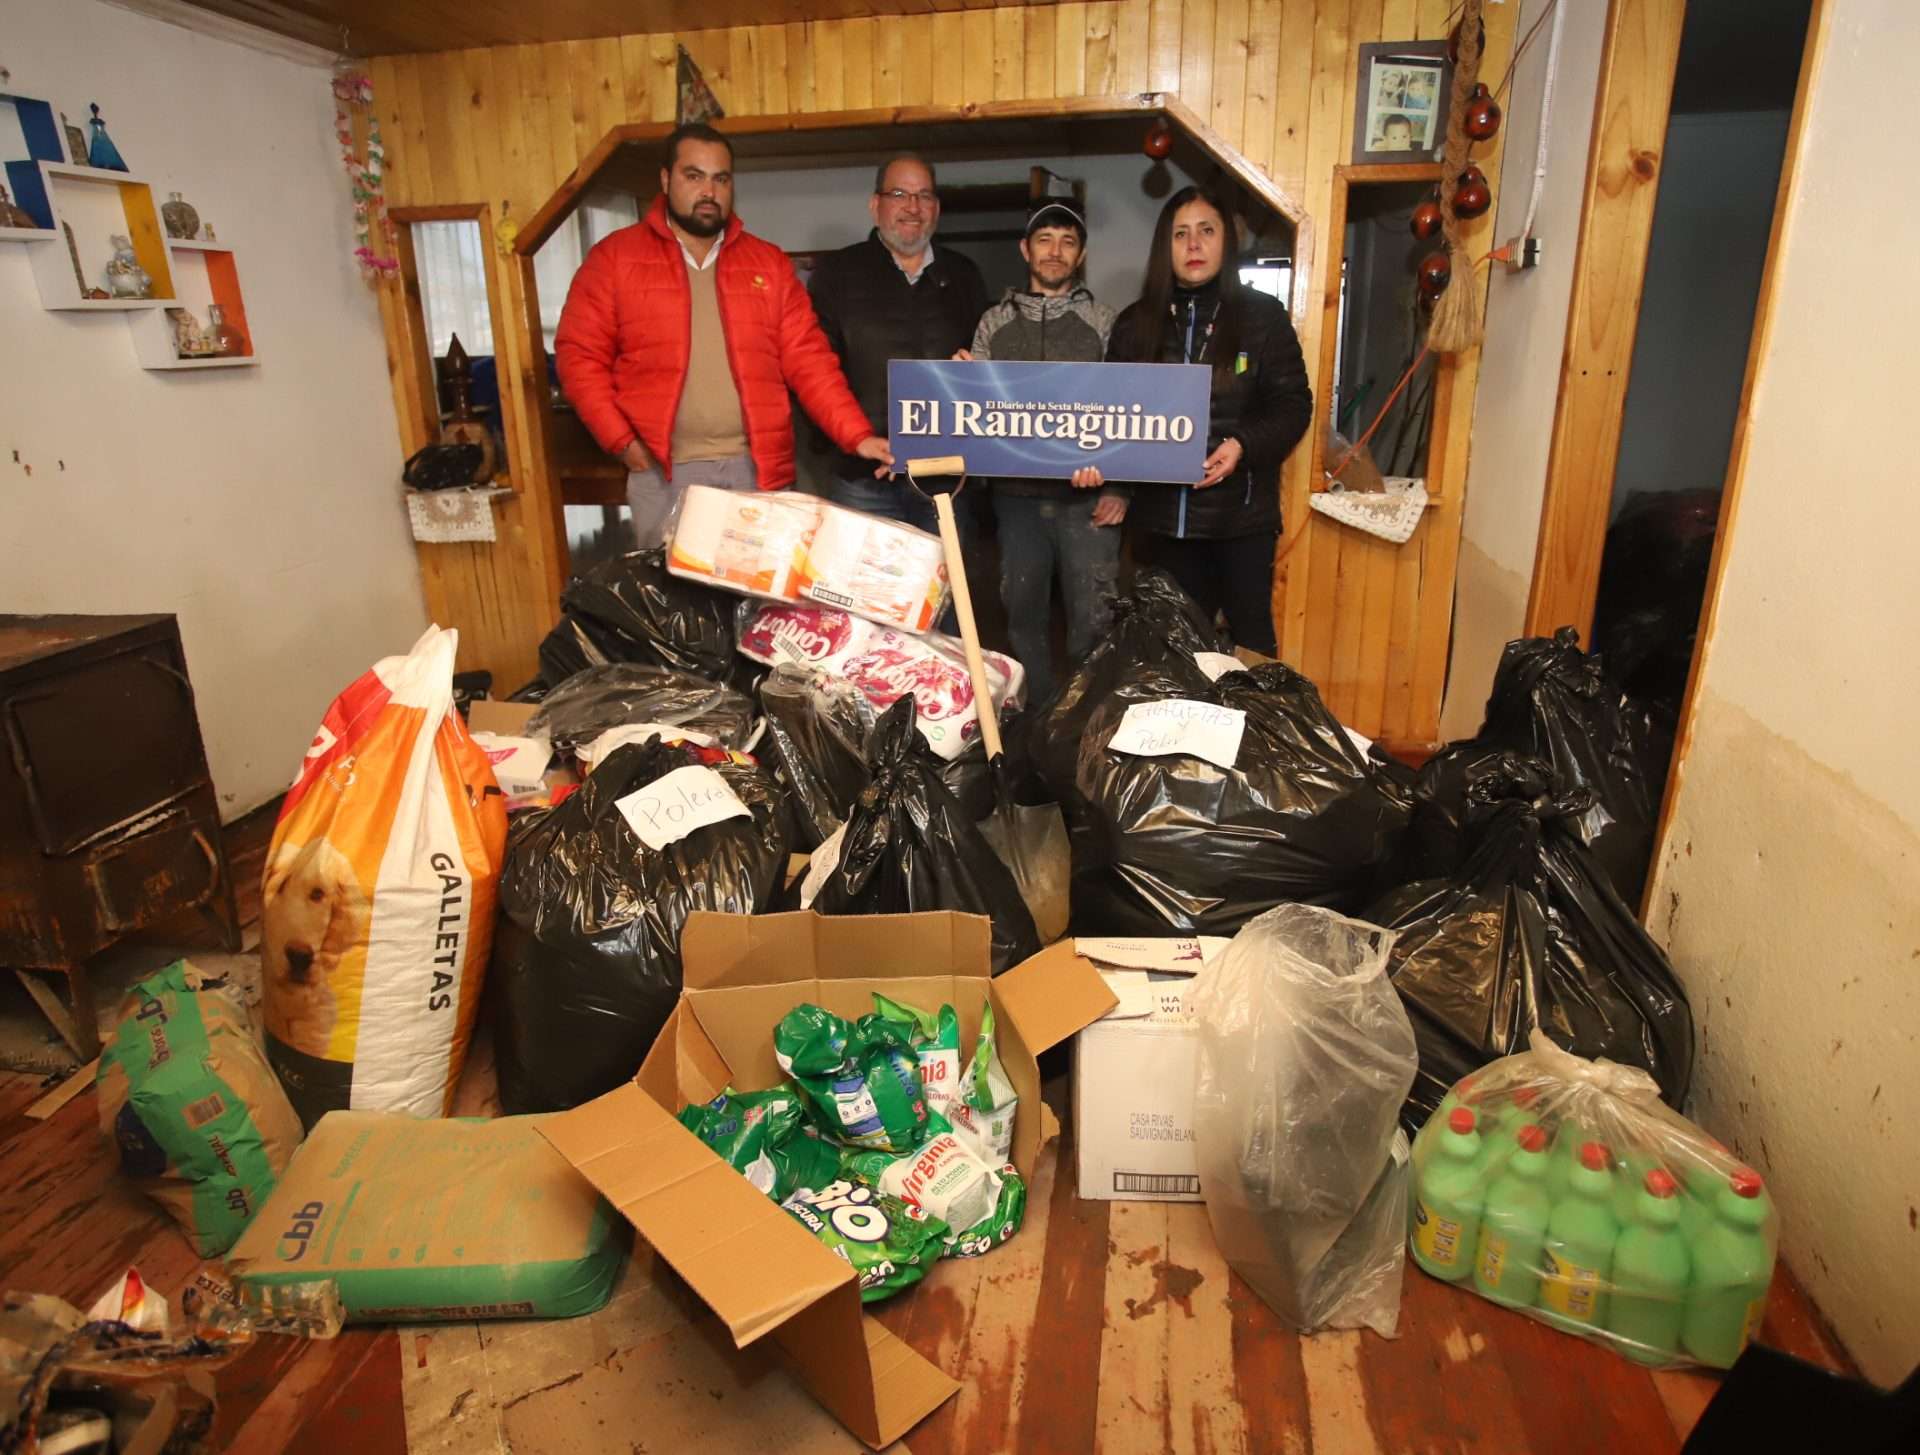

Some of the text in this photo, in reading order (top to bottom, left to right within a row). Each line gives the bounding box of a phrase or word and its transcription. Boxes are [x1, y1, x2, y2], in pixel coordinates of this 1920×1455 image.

[898, 399, 1194, 450] El Rancagüino
[985, 400, 1105, 414] El Diario de la Sexta Región
[428, 852, 463, 1013] GALLETAS
[1129, 1112, 1174, 1129] CASA RIVAS
[1129, 1126, 1173, 1142] SAUVIGNON
[900, 1135, 959, 1210] Virginia
[277, 1200, 324, 1262] cbb
